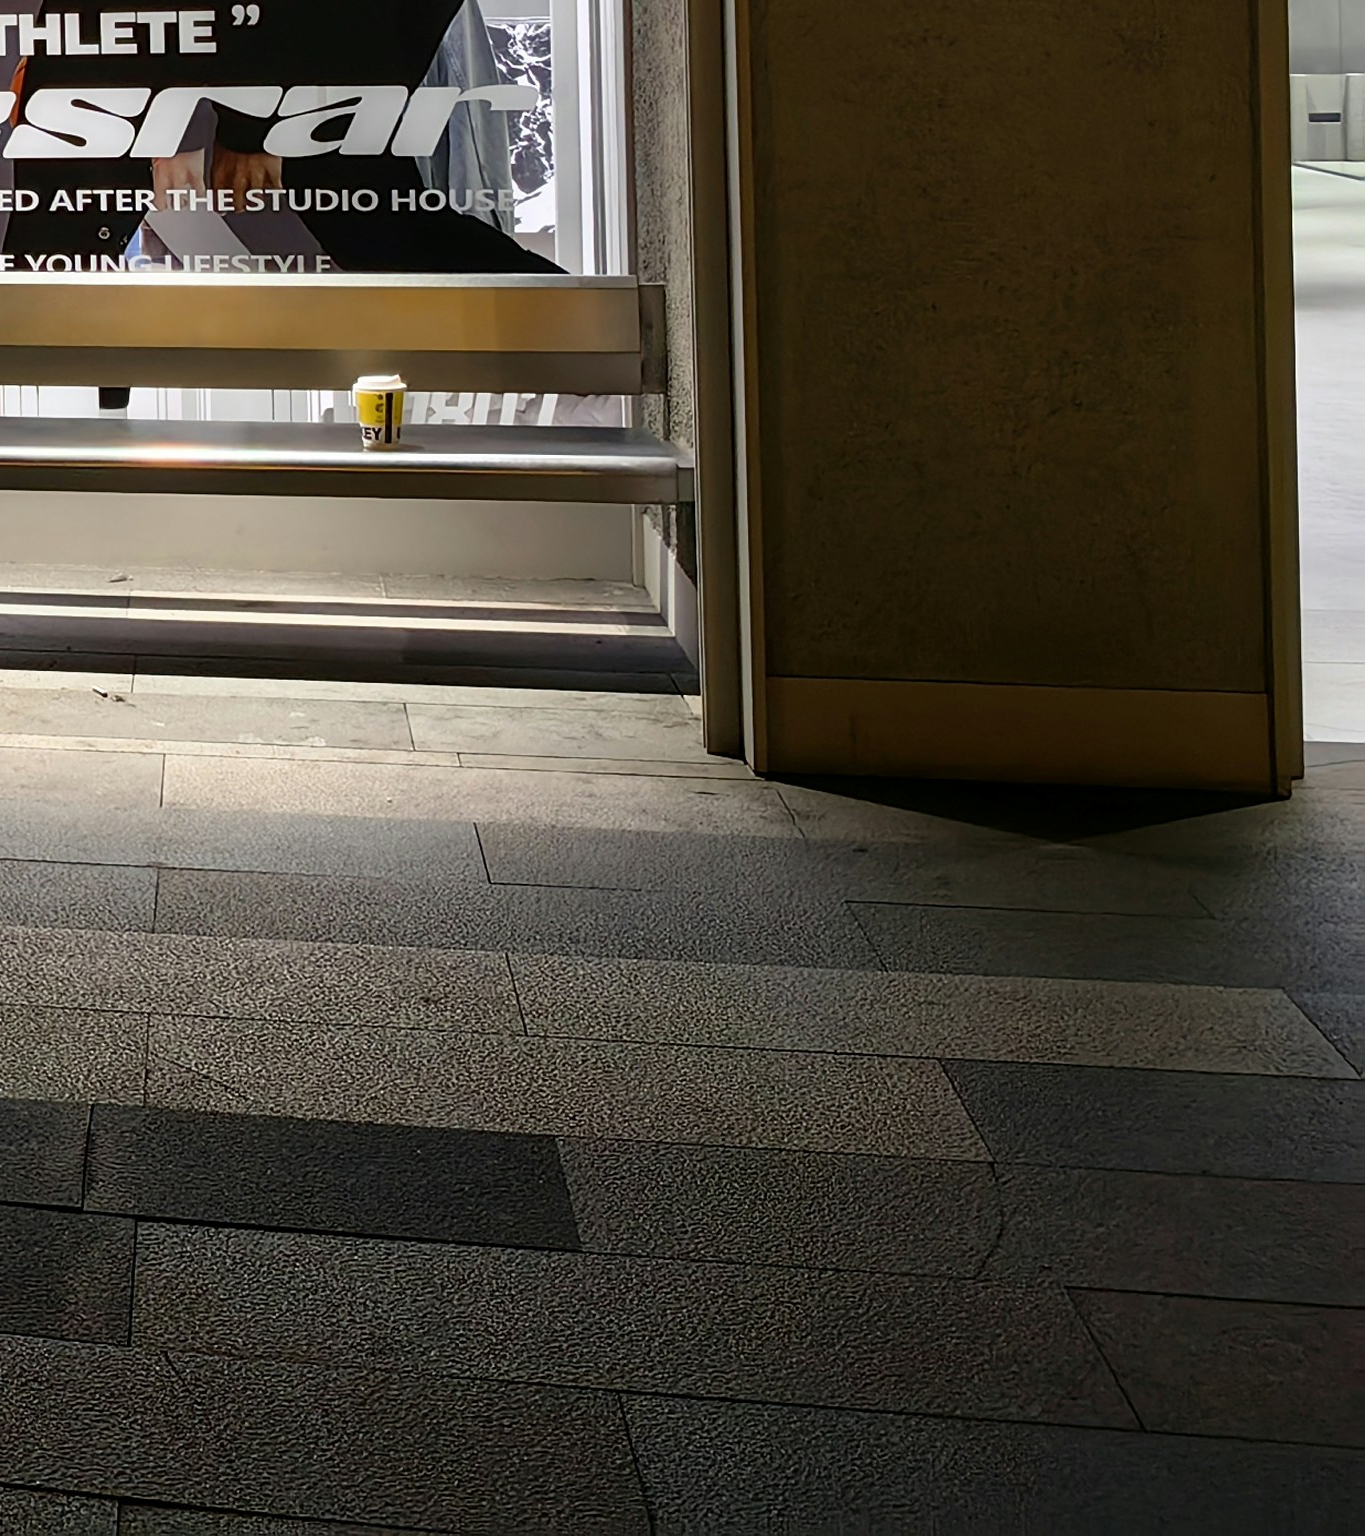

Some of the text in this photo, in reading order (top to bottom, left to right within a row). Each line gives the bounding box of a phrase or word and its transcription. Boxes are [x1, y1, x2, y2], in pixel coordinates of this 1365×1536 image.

[49, 189, 157, 212] AFTER
[166, 189, 235, 212] THE
[245, 189, 379, 212] STUDIO
[392, 189, 514, 212] HOUSE
